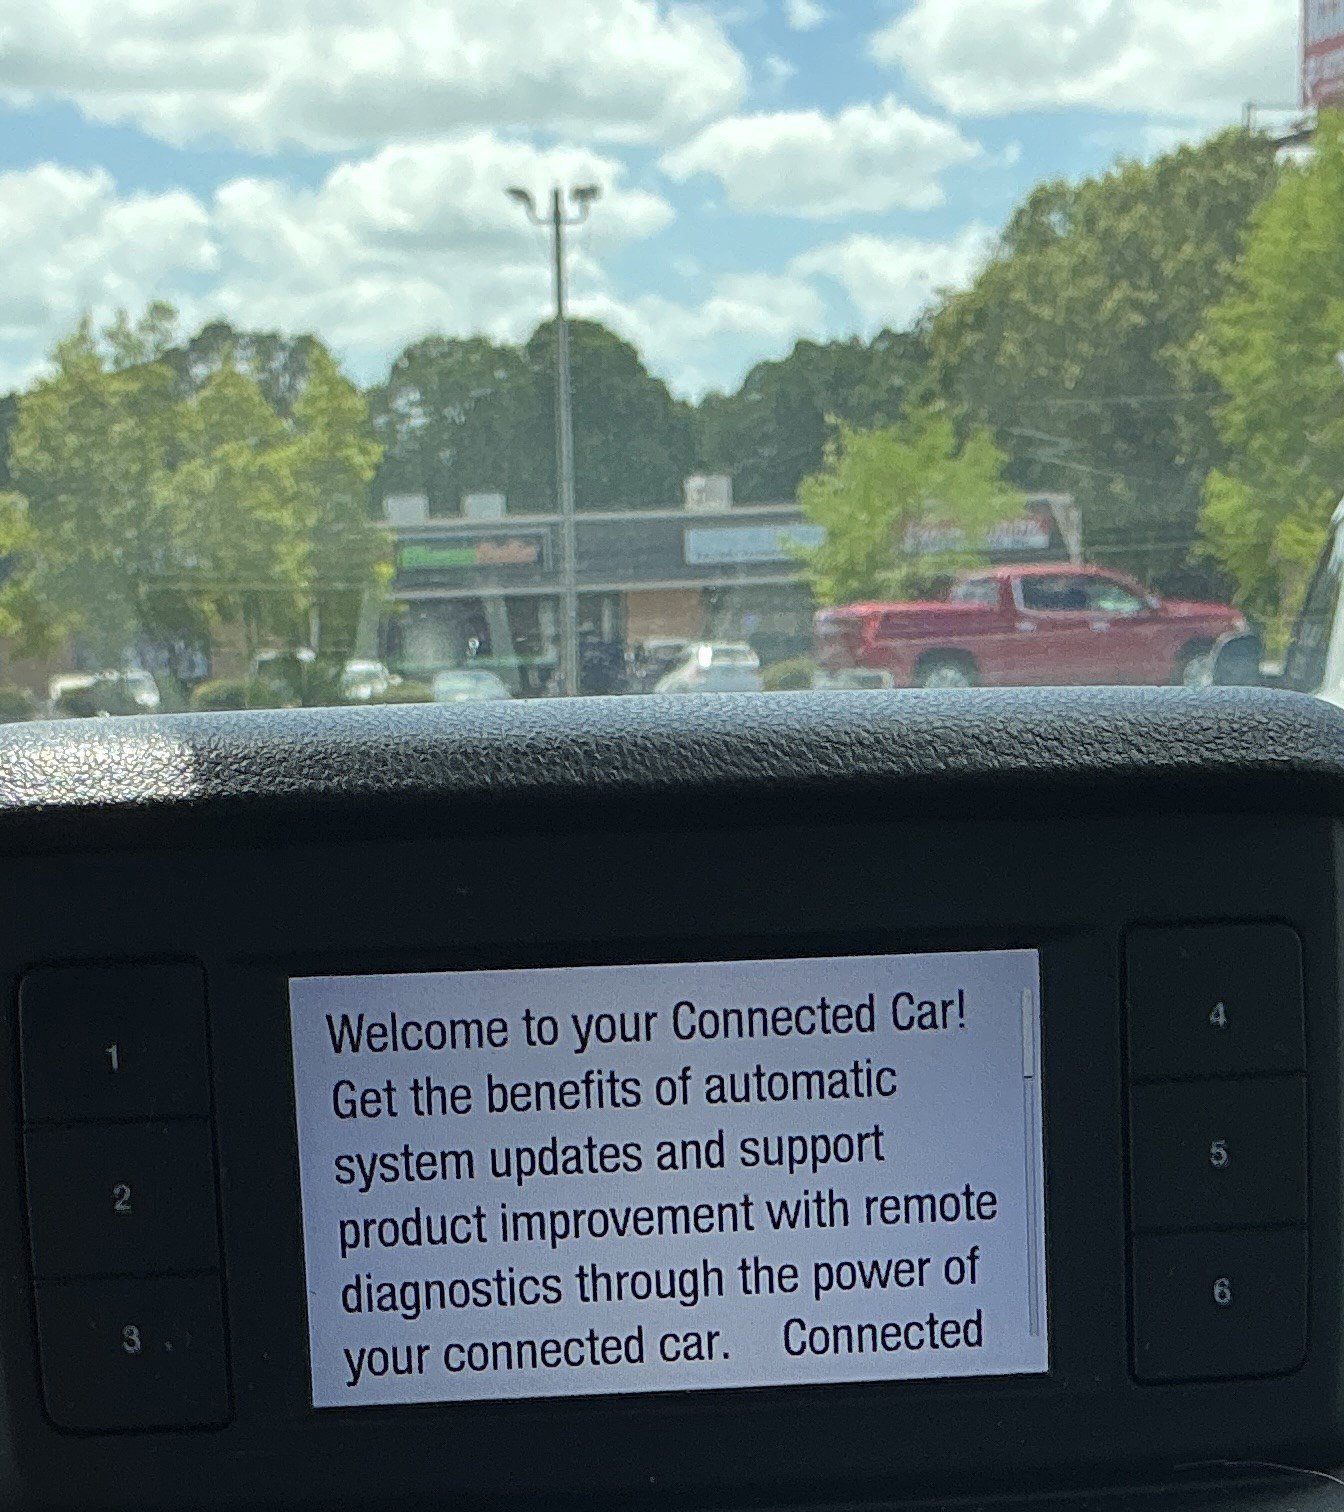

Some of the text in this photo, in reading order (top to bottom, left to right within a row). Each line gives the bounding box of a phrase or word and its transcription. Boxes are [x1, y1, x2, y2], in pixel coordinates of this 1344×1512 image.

[325, 988, 965, 1054] Welcome to your Connected Car!
[1209, 1002, 1227, 1027] 4
[105, 1043, 119, 1071] 1
[332, 1060, 897, 1120] Get the benefits of automatic
[334, 1124, 885, 1194] system updates and support
[1210, 1140, 1229, 1167] 5
[113, 1184, 132, 1211] 2
[339, 1183, 998, 1259] product improvement with remote
[341, 1245, 981, 1321] diagnostics through the power of
[1213, 1277, 1232, 1304] 6
[122, 1325, 141, 1354] 3
[343, 1308, 983, 1388] your connected car. Connected
